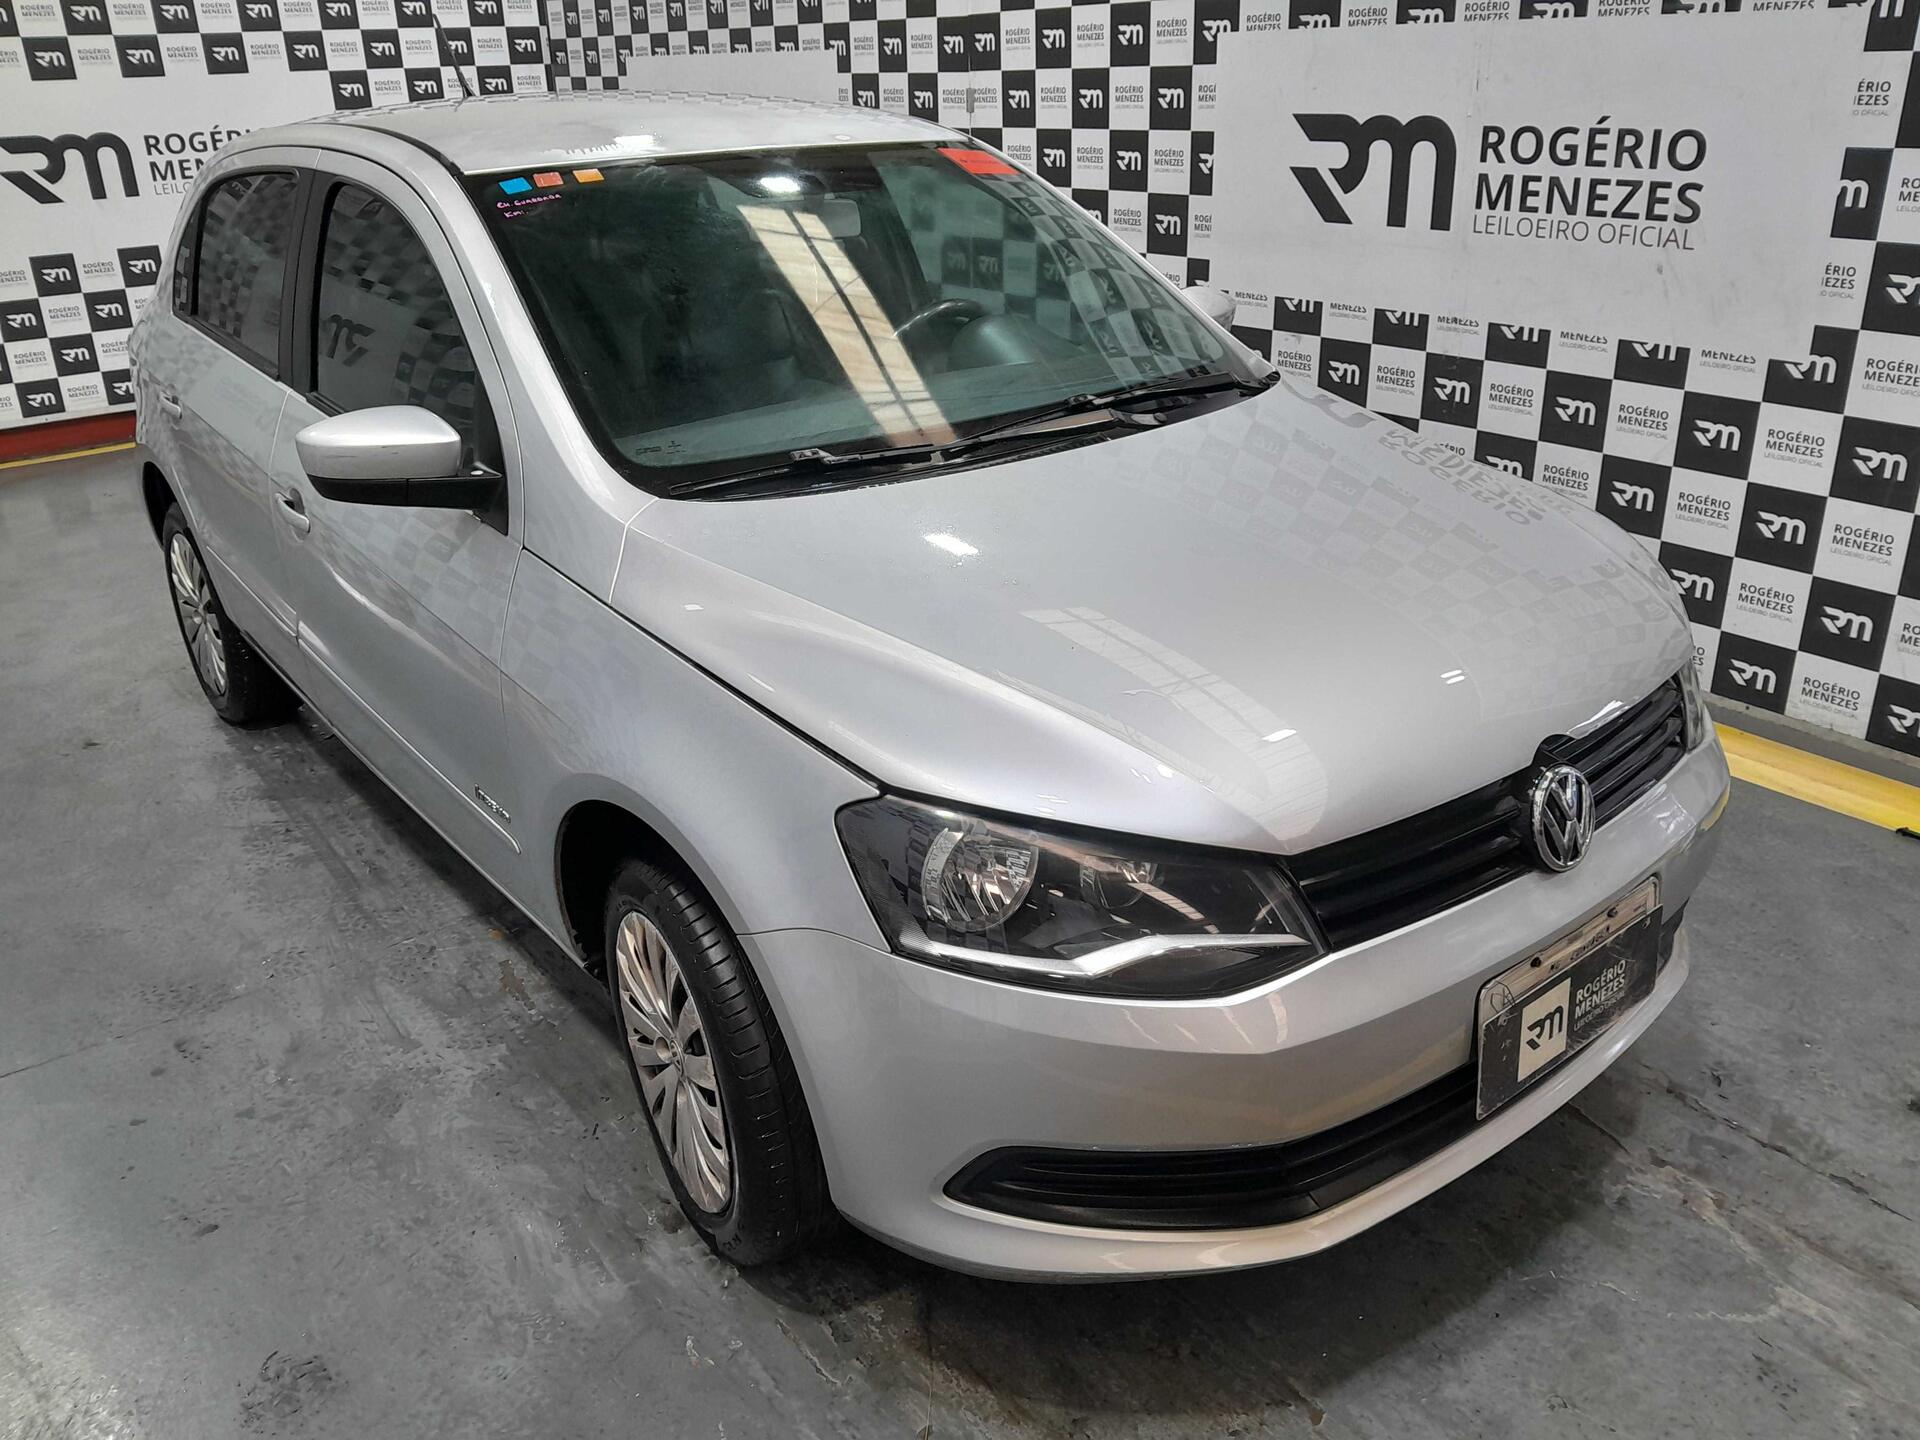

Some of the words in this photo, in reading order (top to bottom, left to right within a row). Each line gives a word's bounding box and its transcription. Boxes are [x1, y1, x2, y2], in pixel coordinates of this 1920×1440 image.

[1479, 115, 1707, 171] ROGÉRIO
[1474, 172, 1704, 224] MENEZES
[1472, 214, 1590, 242] LEILOEIRO
[1597, 222, 1696, 251] OFICIAL
[1617, 414, 1668, 431] MENEZES
[1619, 404, 1669, 420] ROGÉRIO
[1767, 428, 1825, 447] ROGÉRIO
[1765, 439, 1824, 459] MENEZES
[1542, 474, 1588, 491] MENEZES
[1543, 464, 1589, 481] ROGÉRIO
[1676, 502, 1730, 522] MENEZES
[1678, 492, 1731, 510] ROGÉRIO
[1834, 523, 1895, 545] ROGÉRIO
[1832, 535, 1893, 557] MENEZES
[1739, 582, 1795, 603] ROGÉRIO
[1737, 593, 1793, 615] MENEZES
[1801, 687, 1859, 711] MENEZES
[1803, 676, 1860, 701] ROGÉRIO
[1576, 960, 1626, 1004] ROGÉRIO
[1575, 974, 1626, 1020] MENEZES
